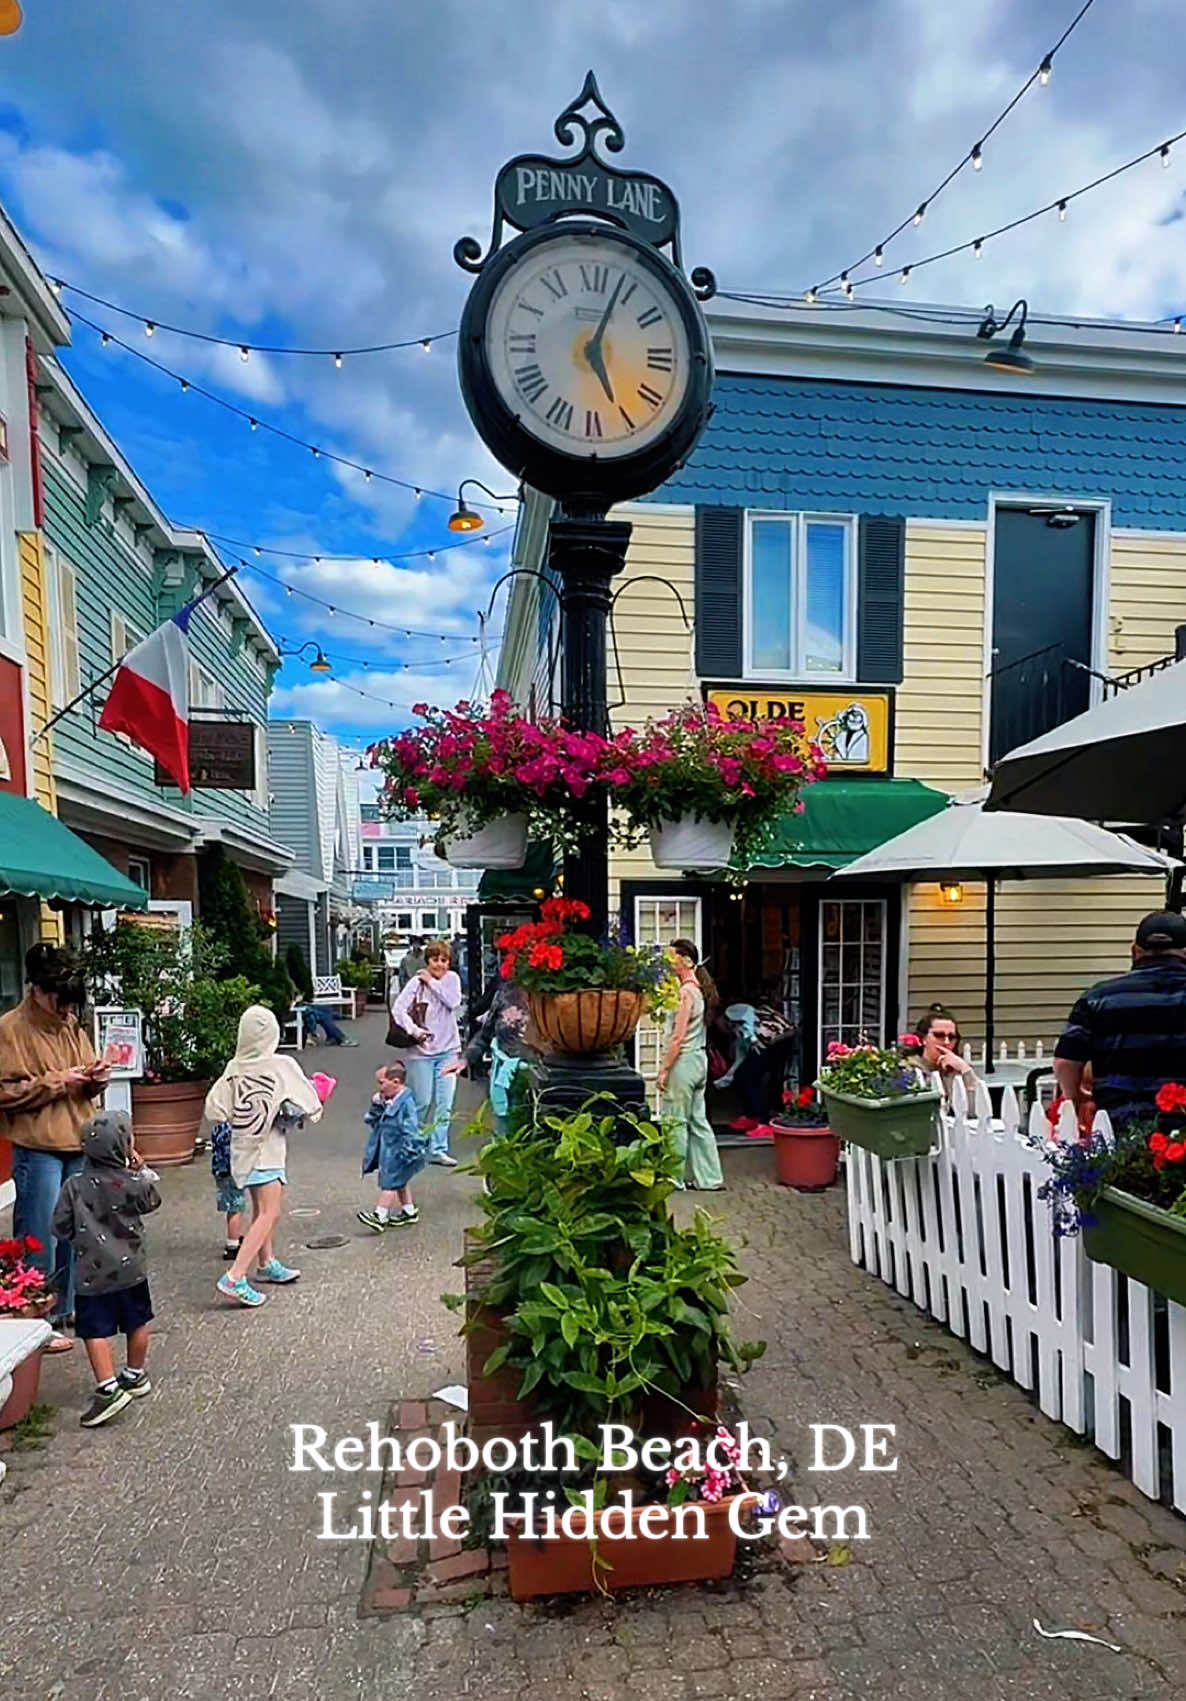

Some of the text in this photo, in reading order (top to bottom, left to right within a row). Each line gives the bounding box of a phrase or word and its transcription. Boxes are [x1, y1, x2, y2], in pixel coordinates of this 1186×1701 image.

[516, 167, 667, 223] PENNY LANE
[726, 700, 805, 722] OLDE
